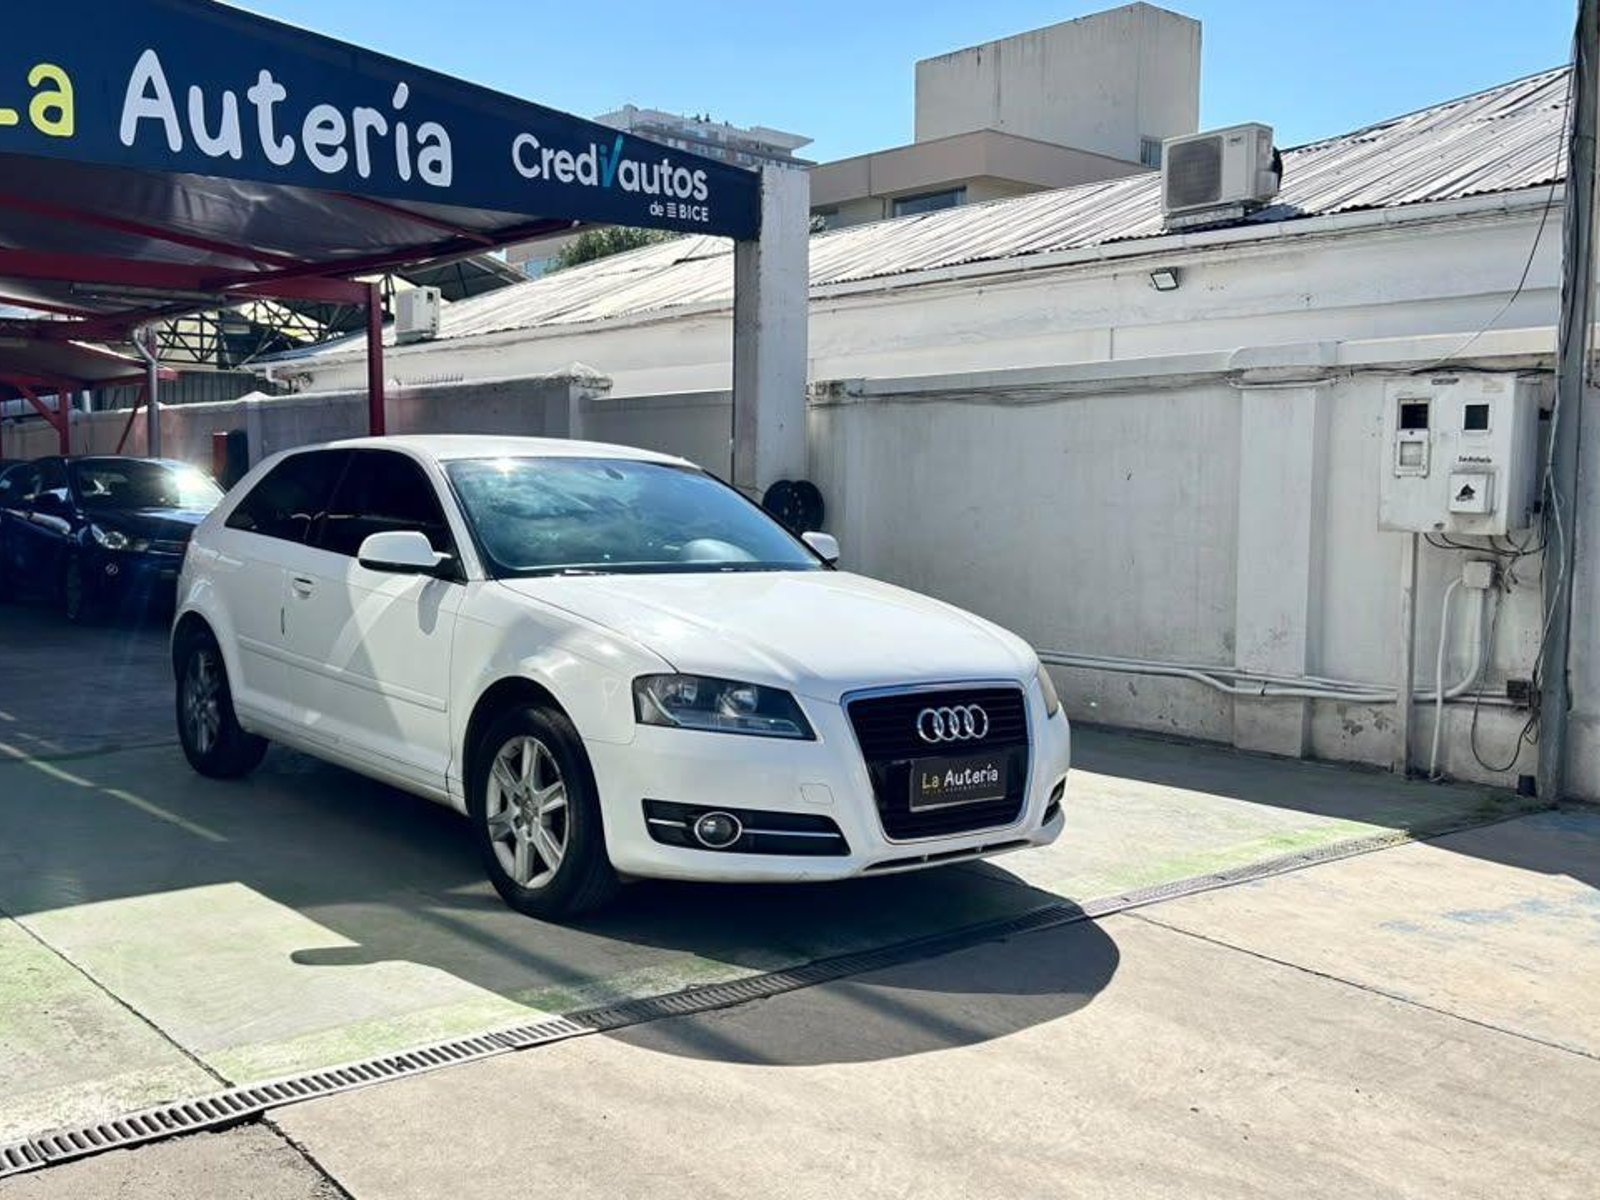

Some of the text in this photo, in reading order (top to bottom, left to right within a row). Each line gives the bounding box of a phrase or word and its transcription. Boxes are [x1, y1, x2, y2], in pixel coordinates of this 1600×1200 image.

[119, 48, 452, 188] Autería
[649, 200, 709, 222] de BICE
[921, 773, 940, 789] La
[943, 764, 998, 787] Autería
